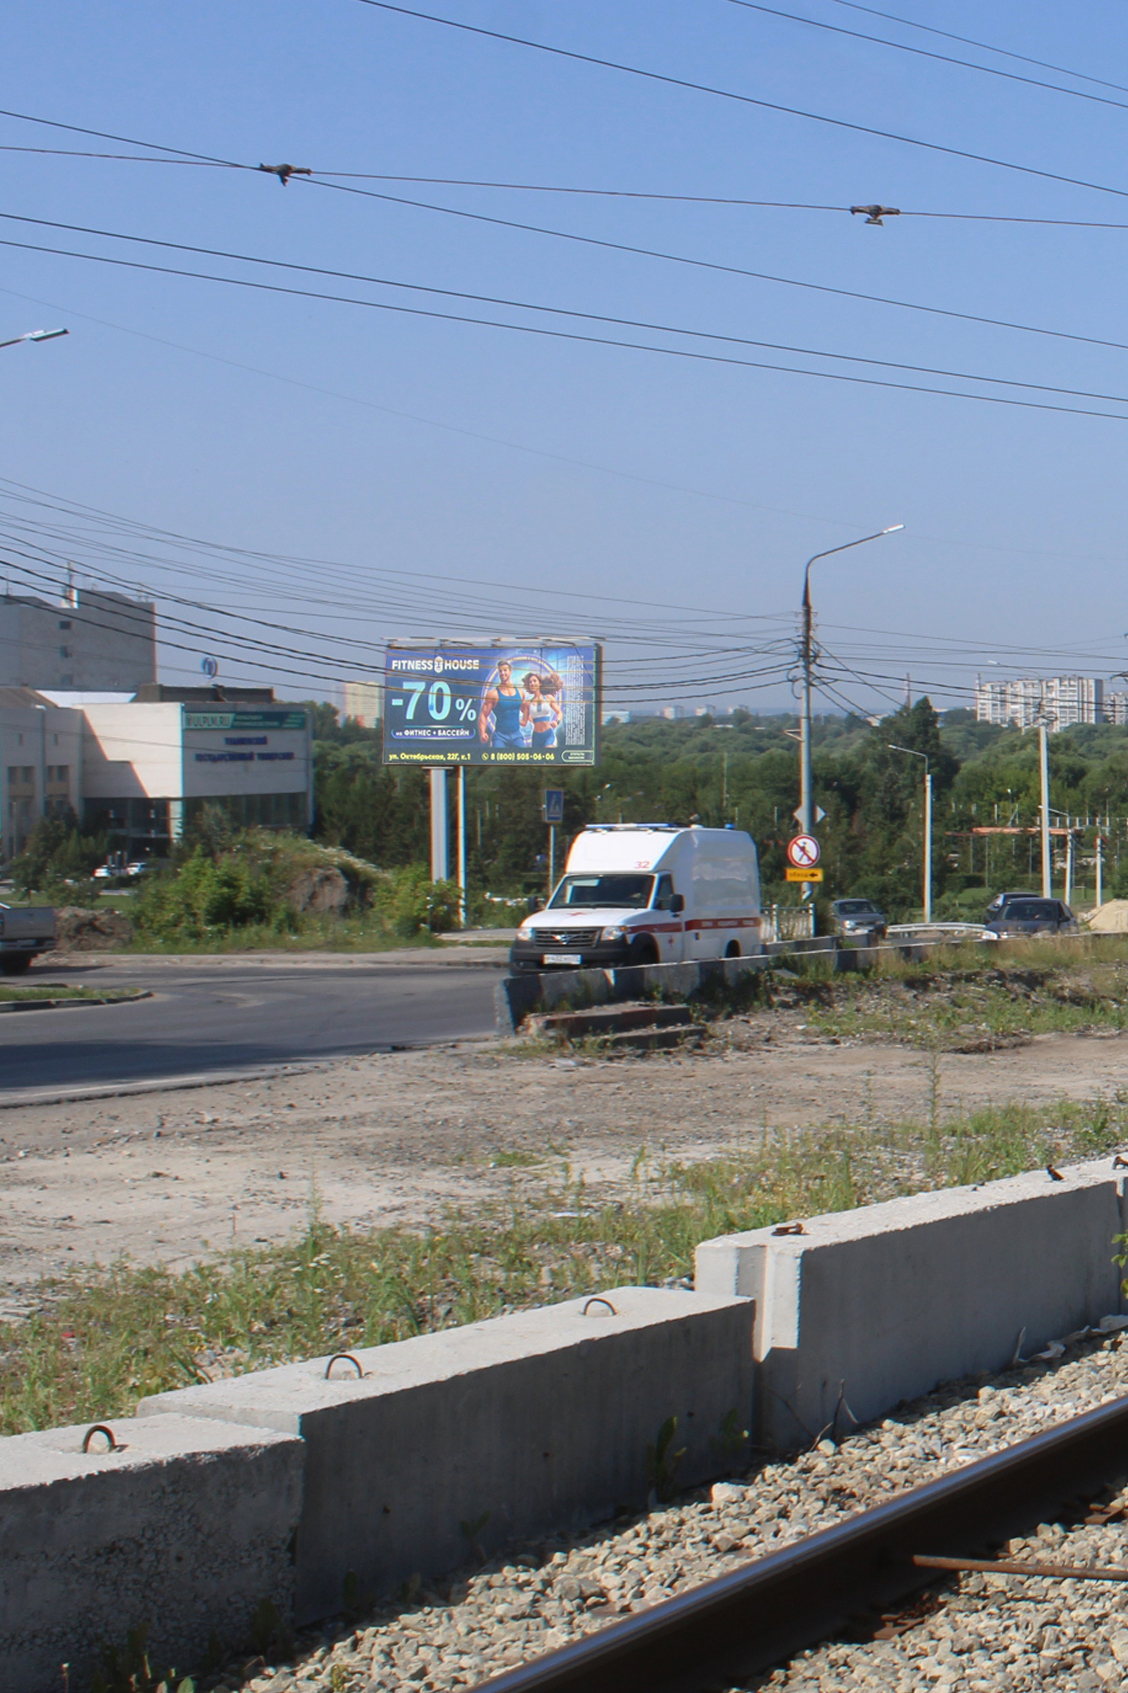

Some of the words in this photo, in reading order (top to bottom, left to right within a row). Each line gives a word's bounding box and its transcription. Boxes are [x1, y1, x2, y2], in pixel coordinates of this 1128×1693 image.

[392, 660, 433, 670] FITNESS
[444, 660, 480, 670] HOUSE
[437, 728, 470, 736] БАССЕЙН
[496, 752, 515, 761] (800)
[634, 861, 650, 869] 32
